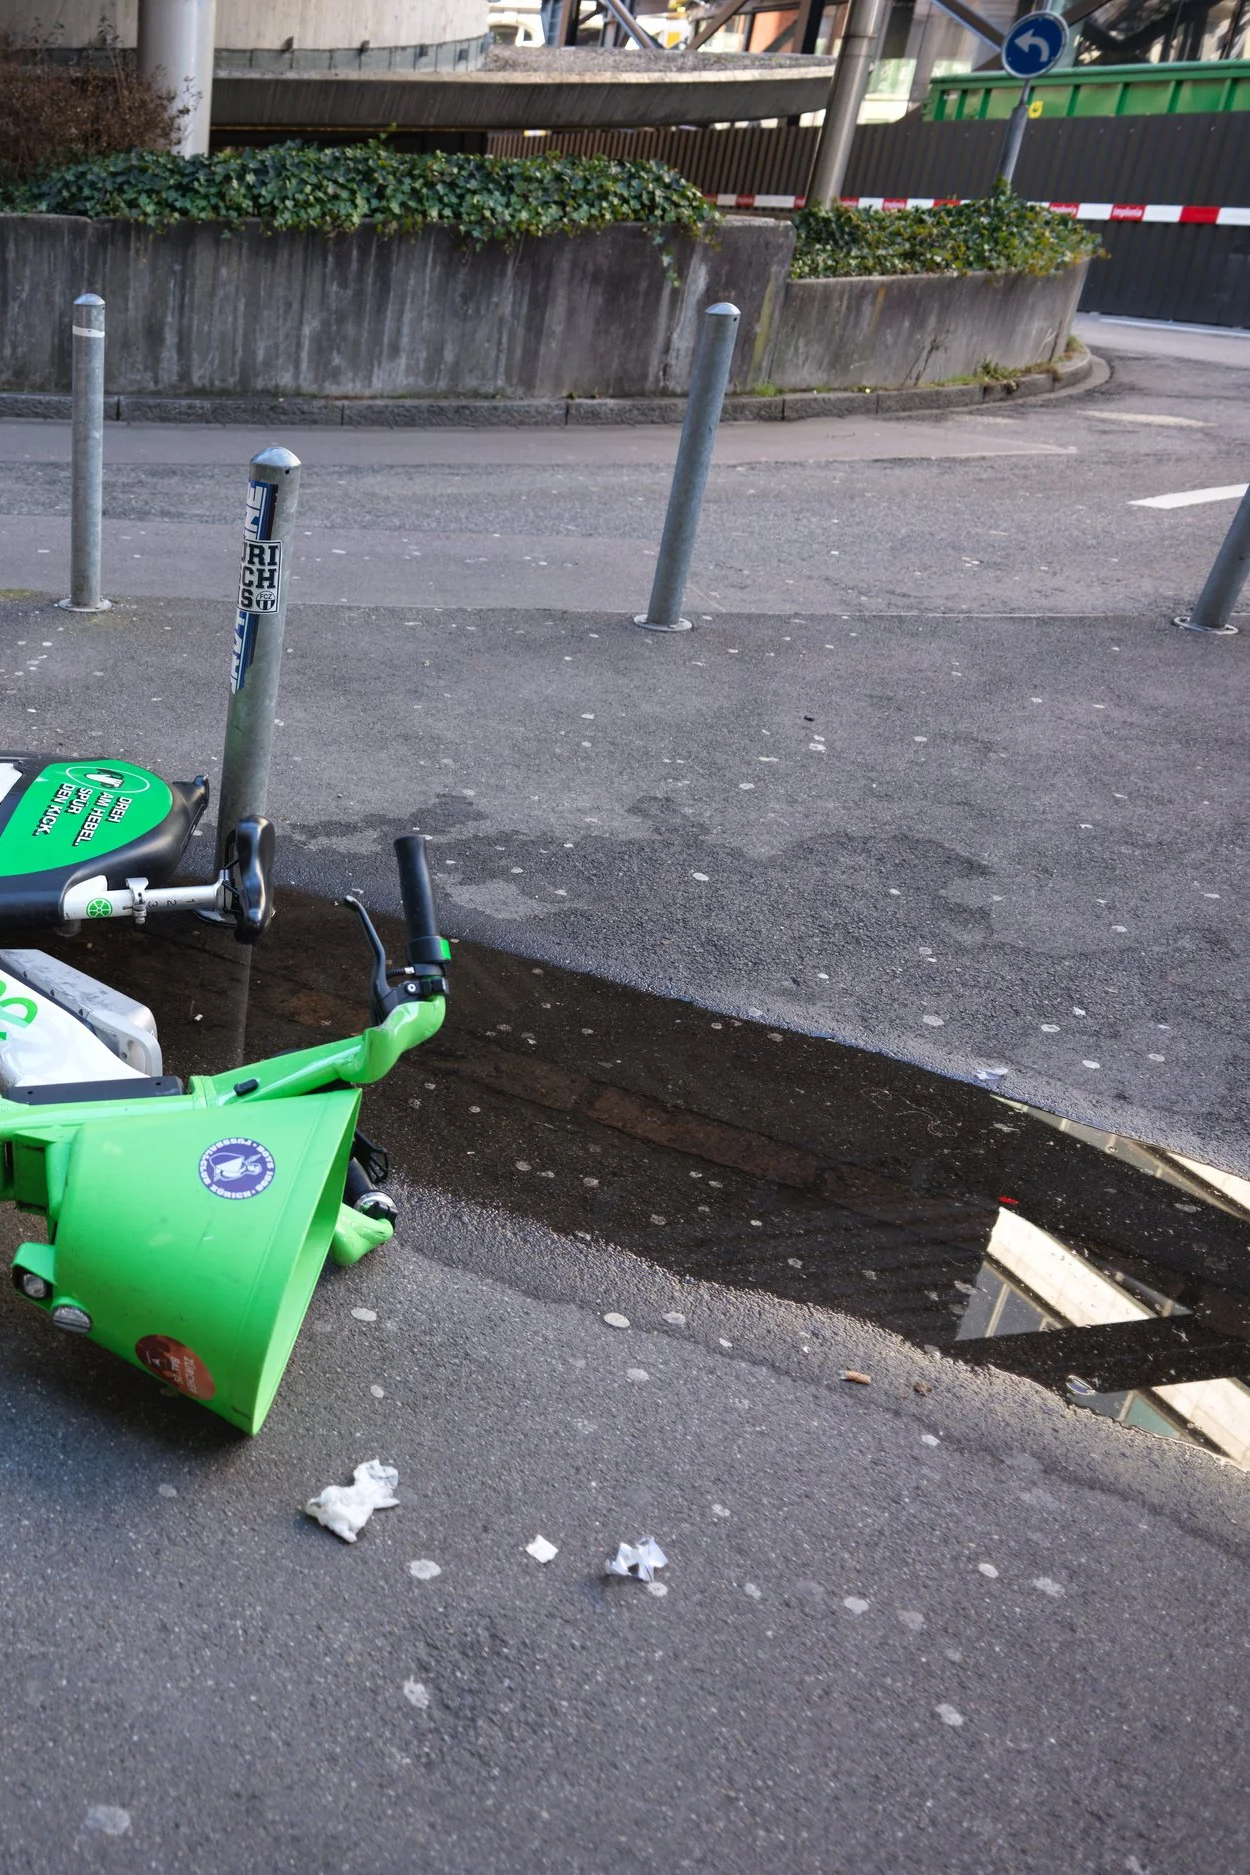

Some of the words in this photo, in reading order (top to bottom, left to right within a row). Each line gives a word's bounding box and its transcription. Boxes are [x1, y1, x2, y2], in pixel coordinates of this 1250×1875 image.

[241, 565, 277, 589] CH
[53, 783, 76, 804] DEN
[67, 787, 94, 814] SPÜR
[95, 791, 114, 807] AM
[35, 804, 63, 836] KICK.
[107, 796, 133, 823] DREH
[74, 807, 106, 846] HEBEL.
